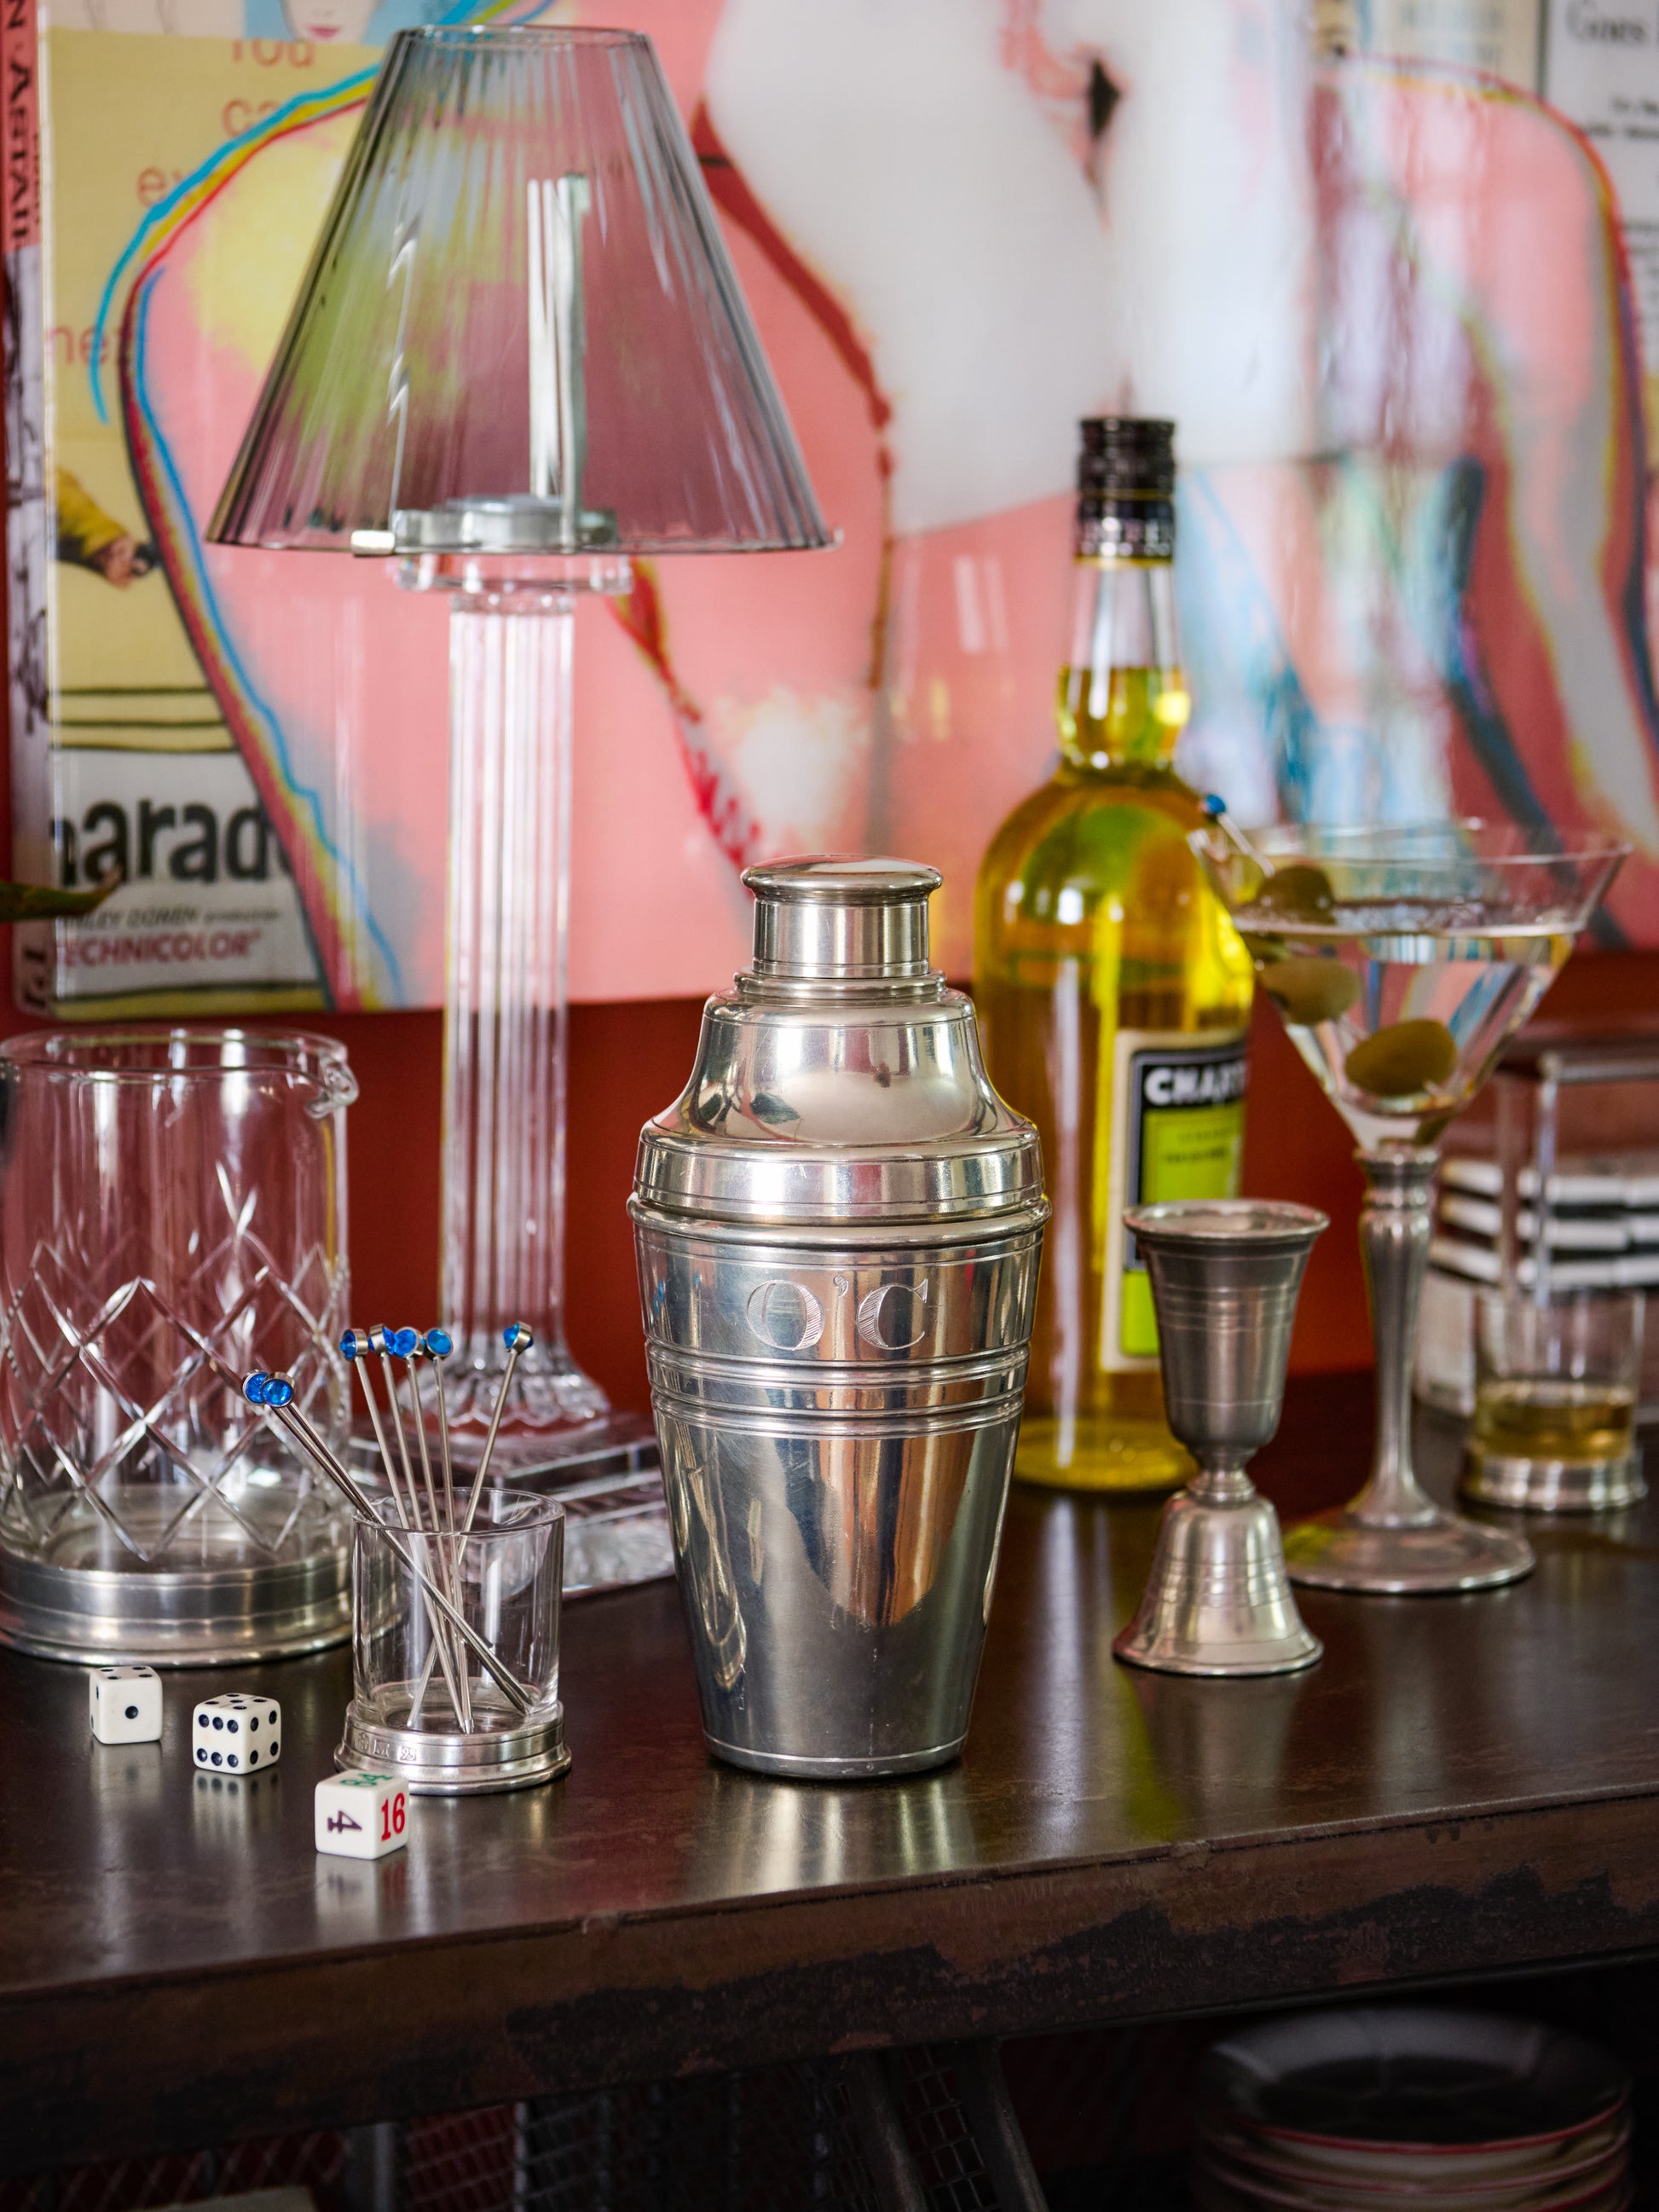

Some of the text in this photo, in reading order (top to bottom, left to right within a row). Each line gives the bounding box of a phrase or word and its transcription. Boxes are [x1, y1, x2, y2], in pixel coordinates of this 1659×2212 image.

[49, 798, 292, 888] arad
[327, 1810, 362, 1833] 4
[380, 1792, 406, 1843] 16
